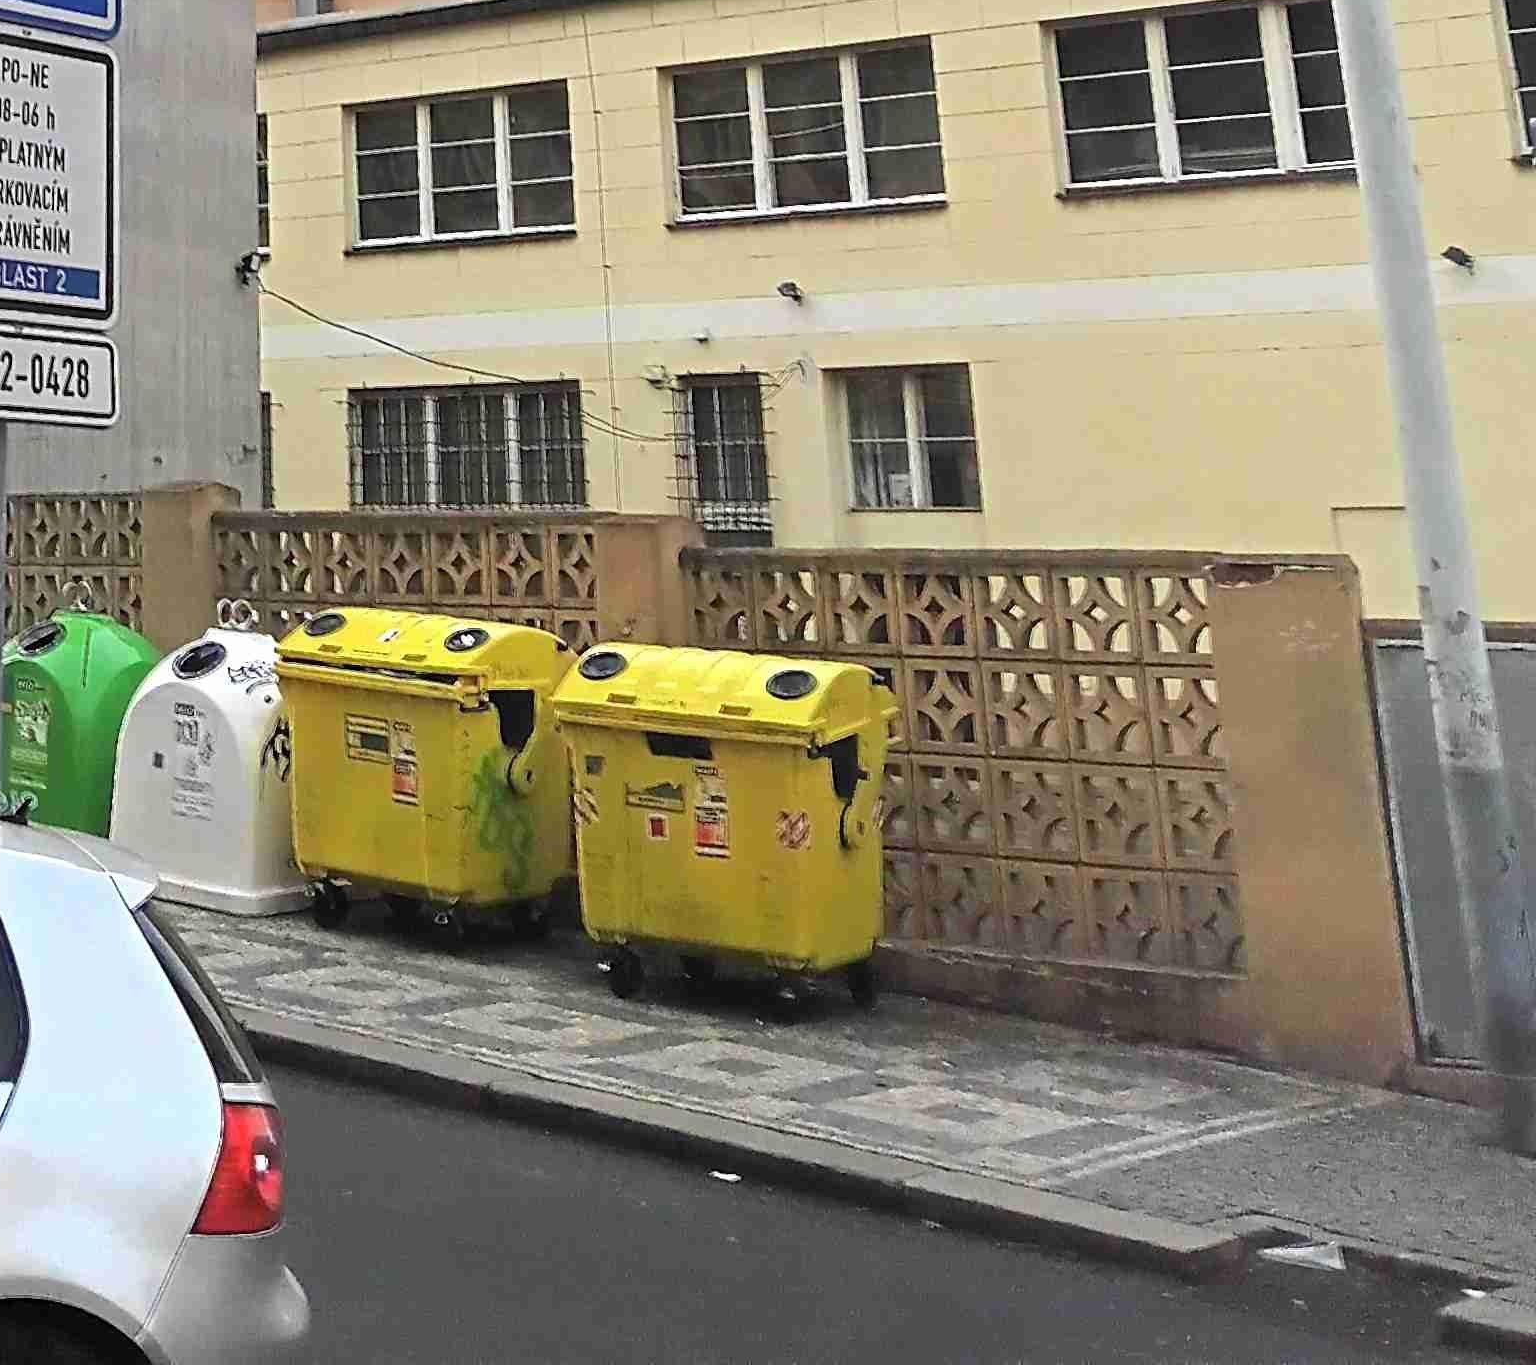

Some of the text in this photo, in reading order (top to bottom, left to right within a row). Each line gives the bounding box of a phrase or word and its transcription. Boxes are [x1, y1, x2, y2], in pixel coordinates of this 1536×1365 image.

[1, 57, 50, 90] PO-NE
[46, 105, 56, 131] h
[54, 268, 67, 294] 2
